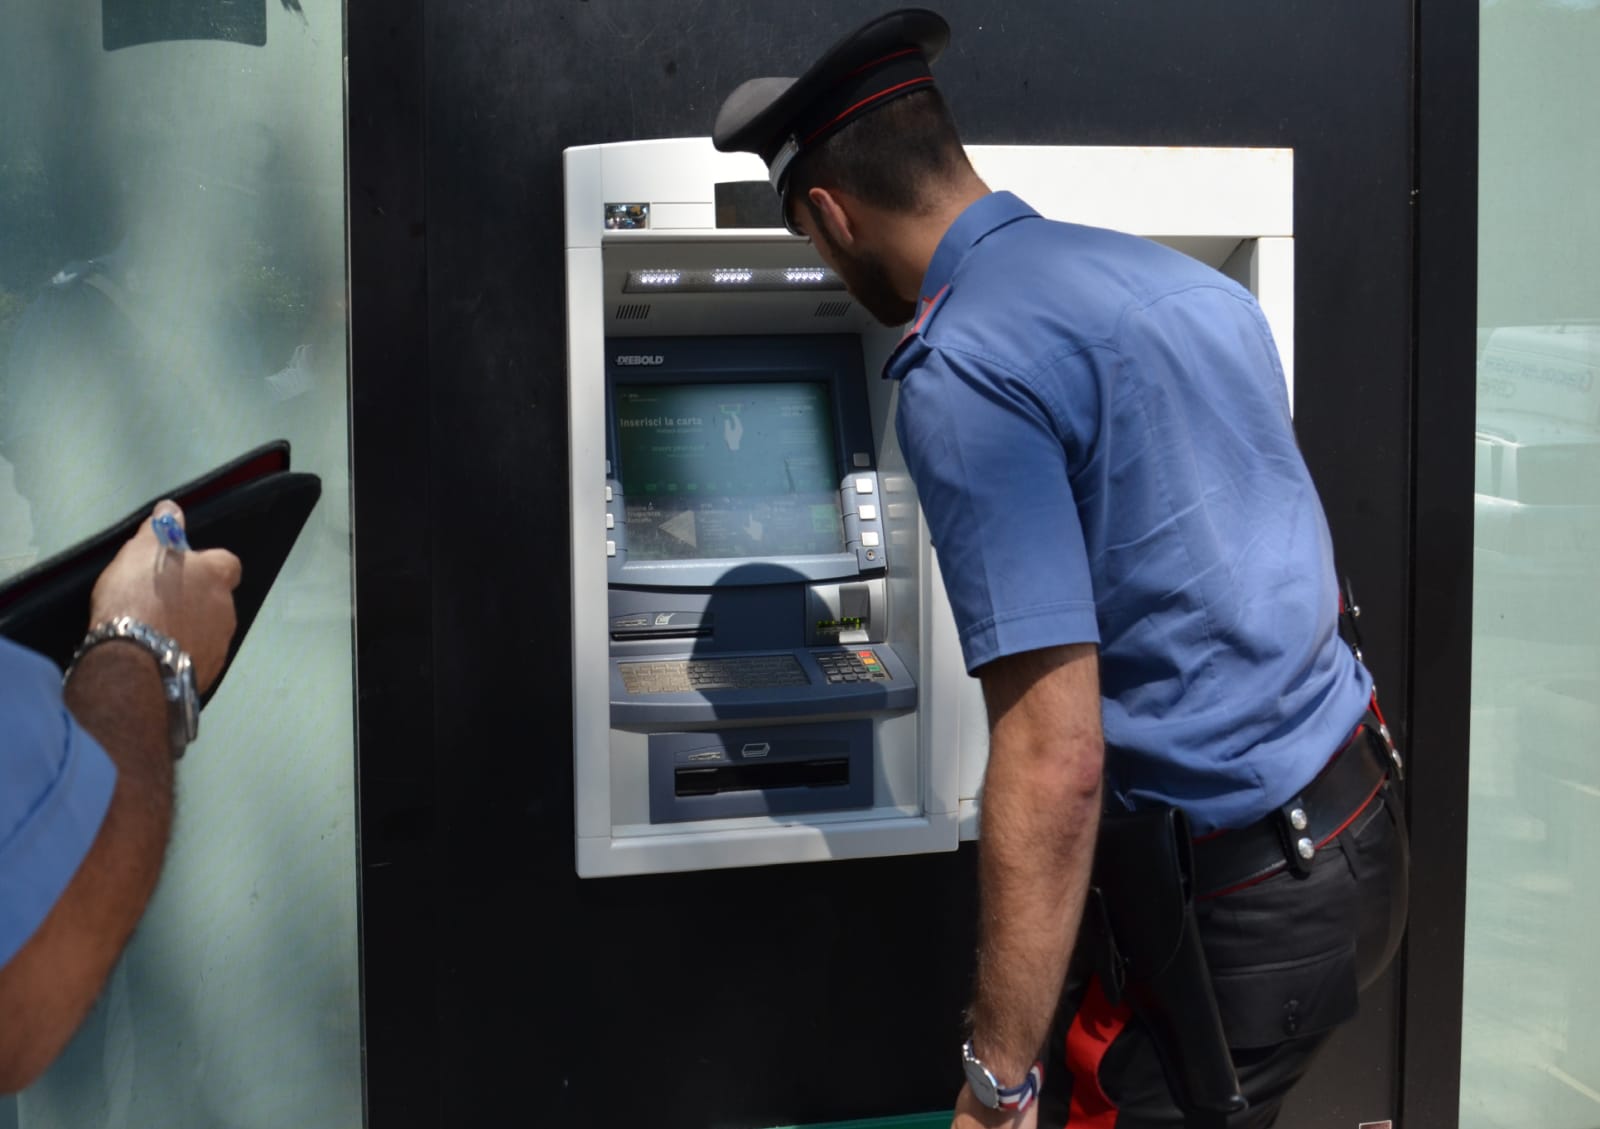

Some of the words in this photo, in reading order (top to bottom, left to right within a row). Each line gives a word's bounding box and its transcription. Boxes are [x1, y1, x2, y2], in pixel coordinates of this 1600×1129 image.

[616, 355, 664, 366] DIEBOLD
[620, 416, 662, 428] Inserisci
[664, 416, 674, 426] la
[676, 416, 703, 426] carta
